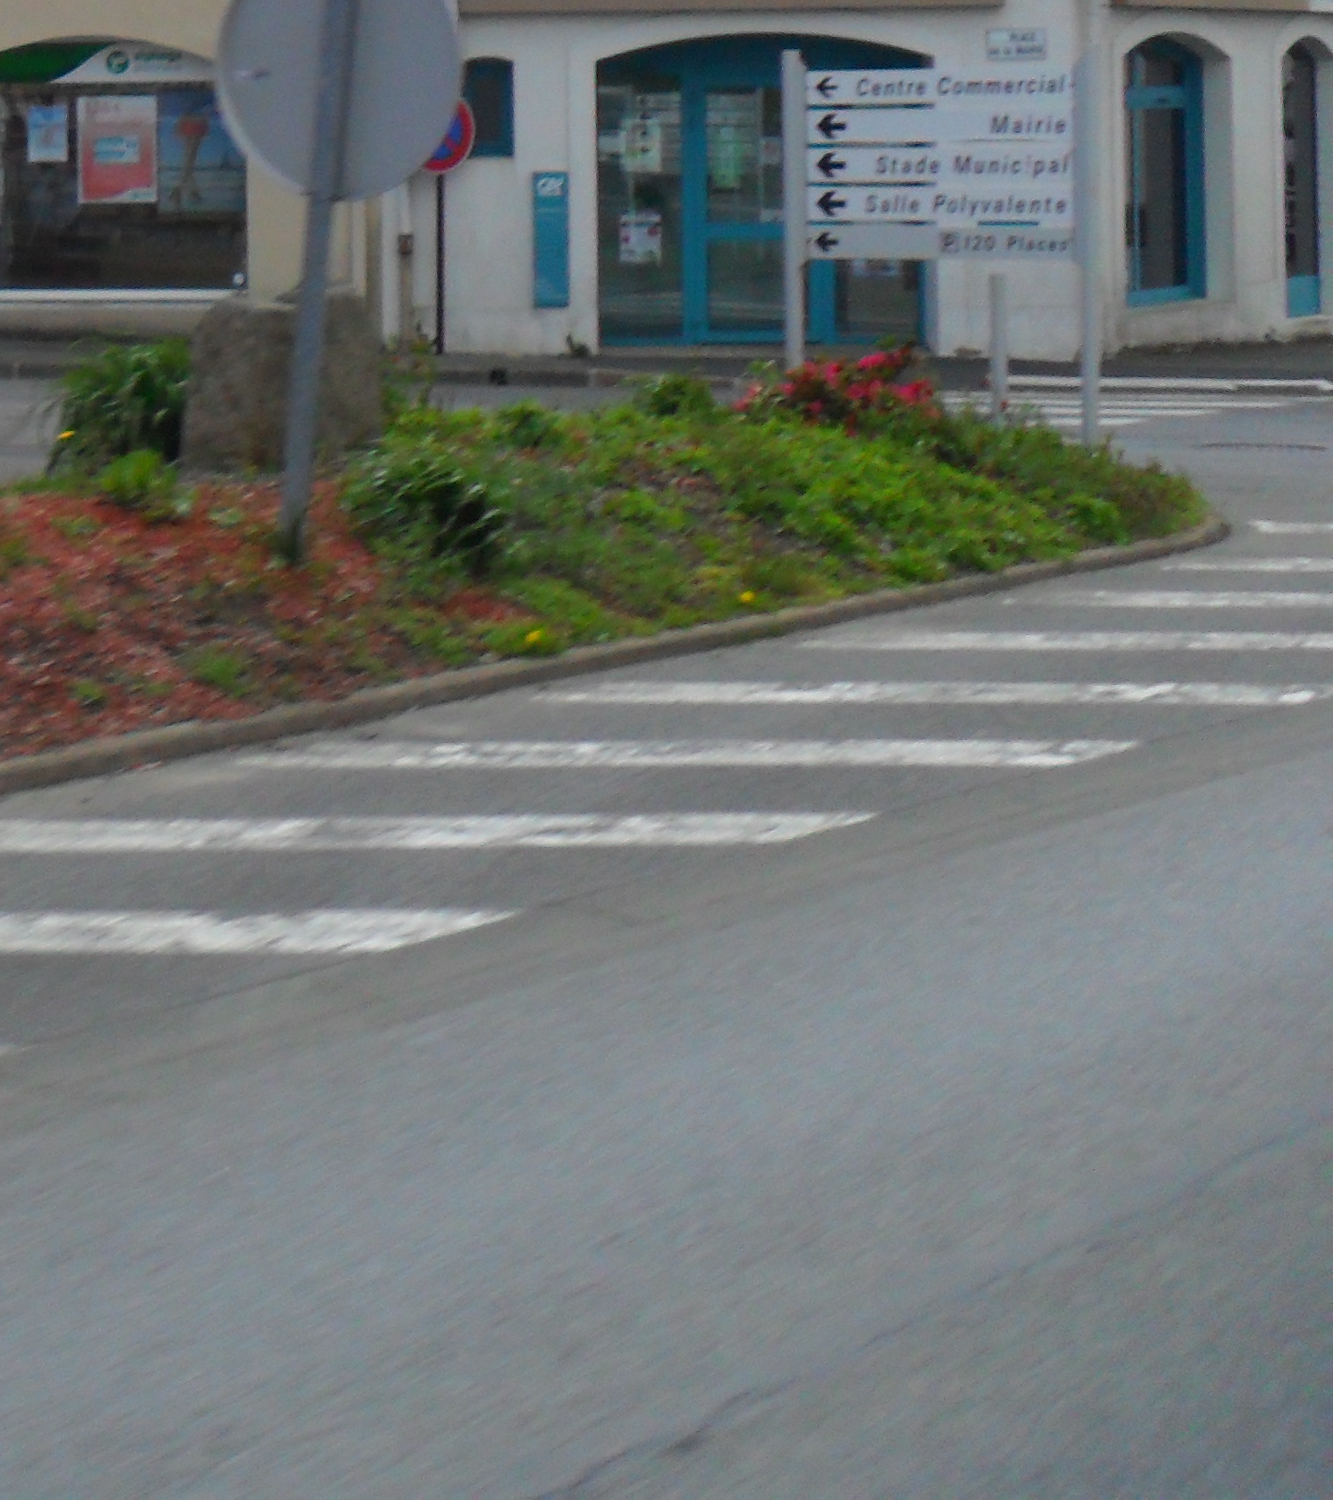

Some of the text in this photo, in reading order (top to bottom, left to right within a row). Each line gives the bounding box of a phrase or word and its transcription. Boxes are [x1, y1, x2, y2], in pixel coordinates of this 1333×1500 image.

[856, 74, 1066, 97] Centre Commercial
[990, 114, 1068, 136] Mairie
[876, 152, 1071, 179] Stade Municipal
[865, 193, 1068, 217] Salle Polyvalente
[964, 234, 996, 252] 120
[1006, 234, 1069, 252] Places
